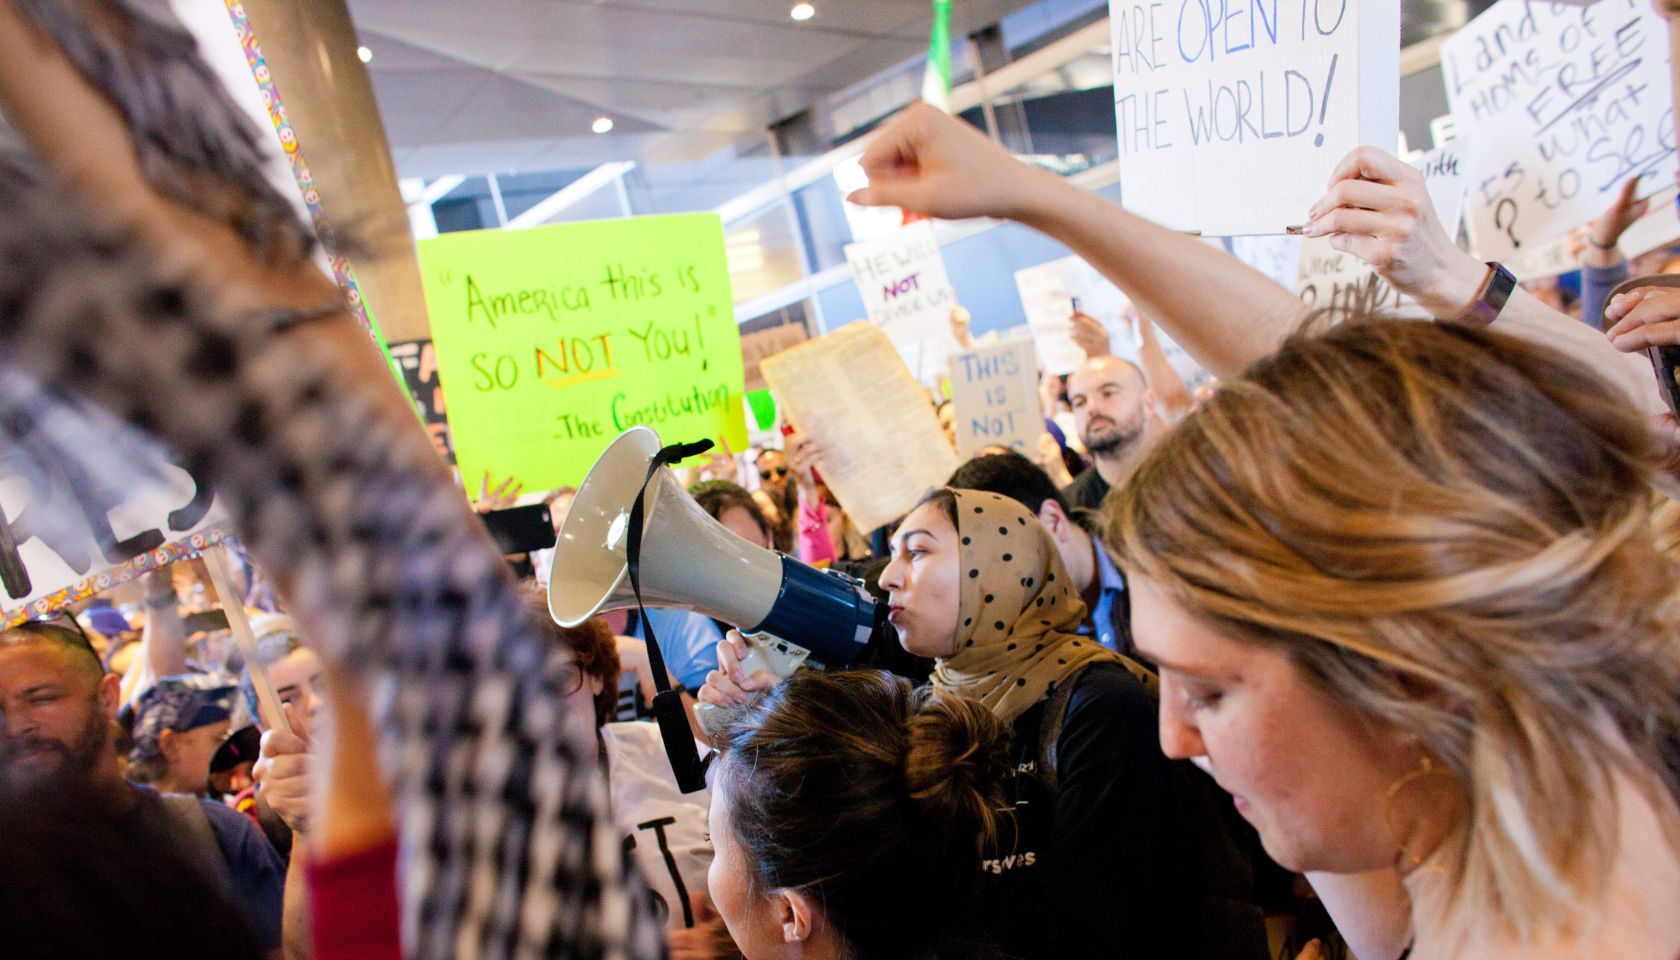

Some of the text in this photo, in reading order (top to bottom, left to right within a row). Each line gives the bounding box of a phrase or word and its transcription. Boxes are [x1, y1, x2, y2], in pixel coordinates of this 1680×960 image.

[1117, 3, 1167, 75] ARE
[1178, 0, 1277, 63] OPEN
[1526, 17, 1648, 125] FREE
[1115, 53, 1339, 154] THE WORLD!
[600, 264, 662, 301] this
[677, 265, 700, 293] is
[852, 252, 891, 281] HE
[882, 271, 921, 303] NOT
[470, 351, 519, 393] SO
[534, 331, 613, 379] NOT
[958, 350, 1020, 384] THIS
[611, 383, 730, 433] Constitution
[985, 385, 1007, 407] IS
